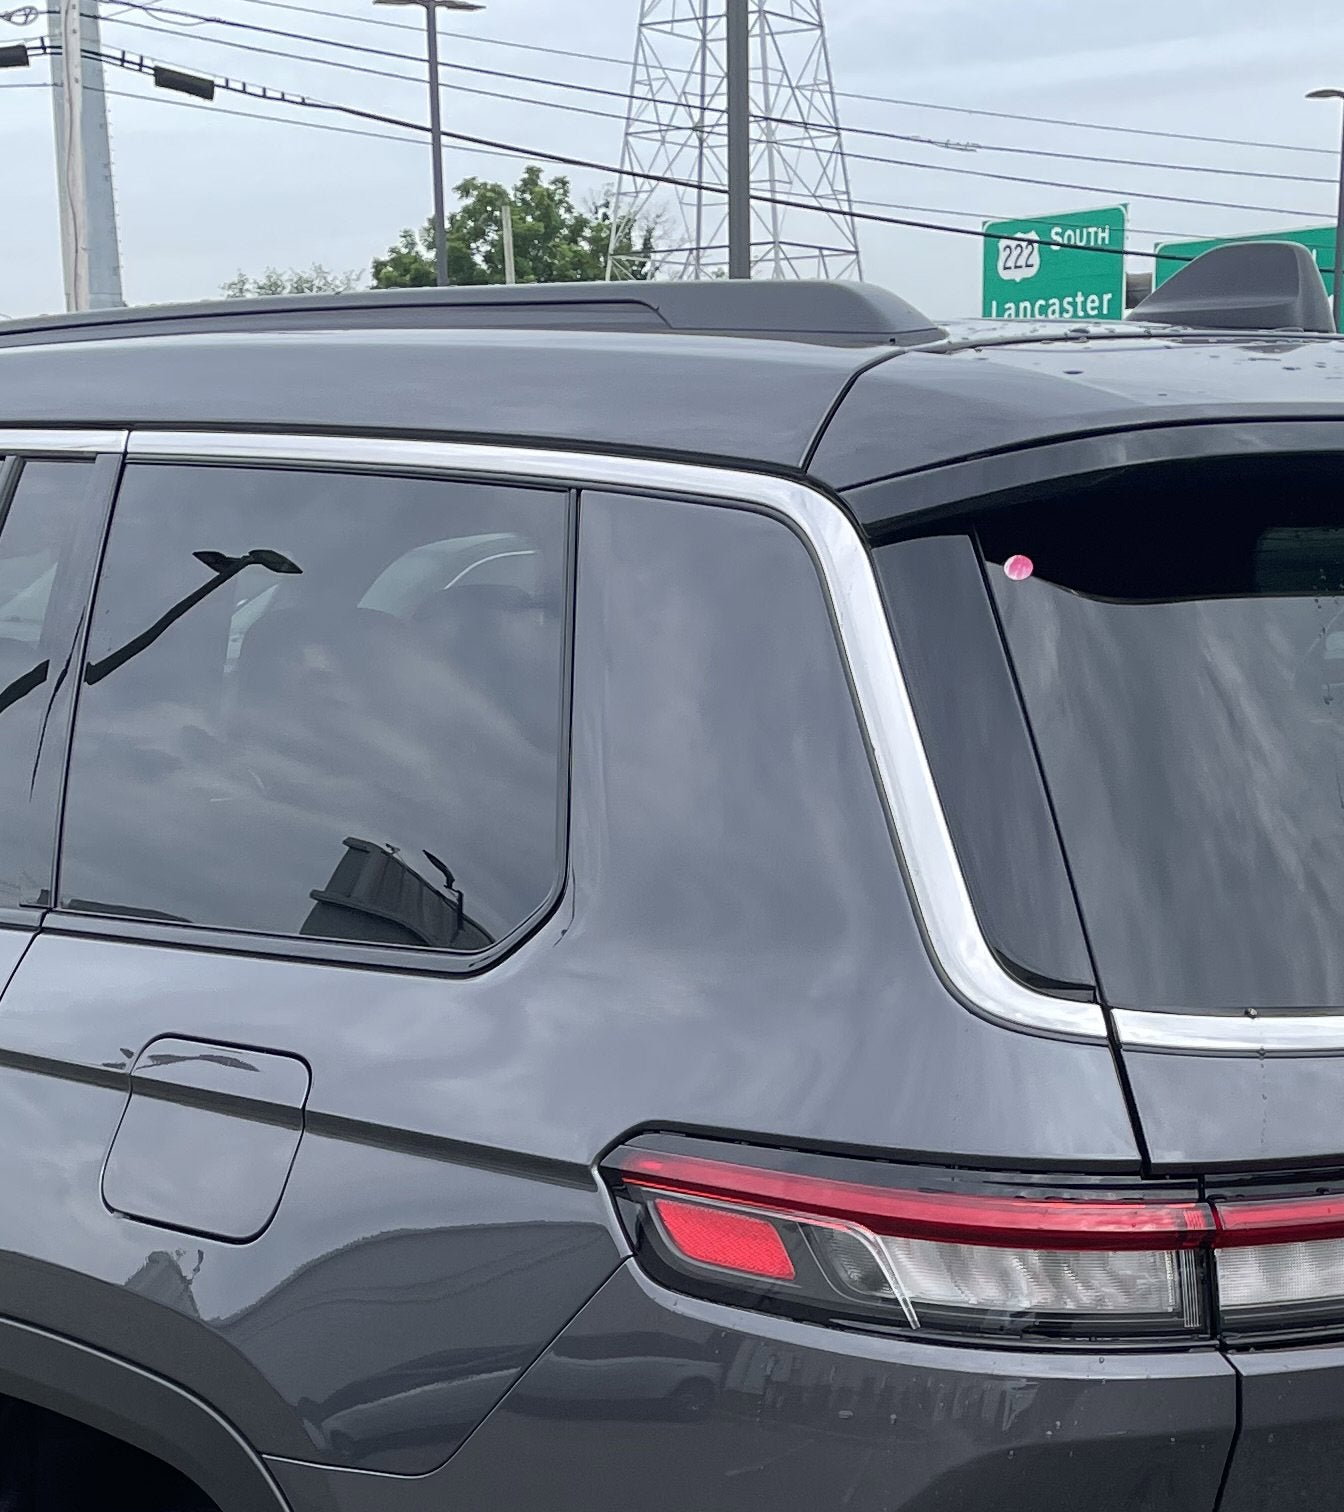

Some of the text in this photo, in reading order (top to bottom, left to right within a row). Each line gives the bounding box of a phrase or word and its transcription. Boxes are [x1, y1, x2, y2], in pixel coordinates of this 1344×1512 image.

[1050, 225, 1110, 250] SOUTH
[1003, 241, 1035, 271] 222
[991, 291, 1113, 319] Lancaster
